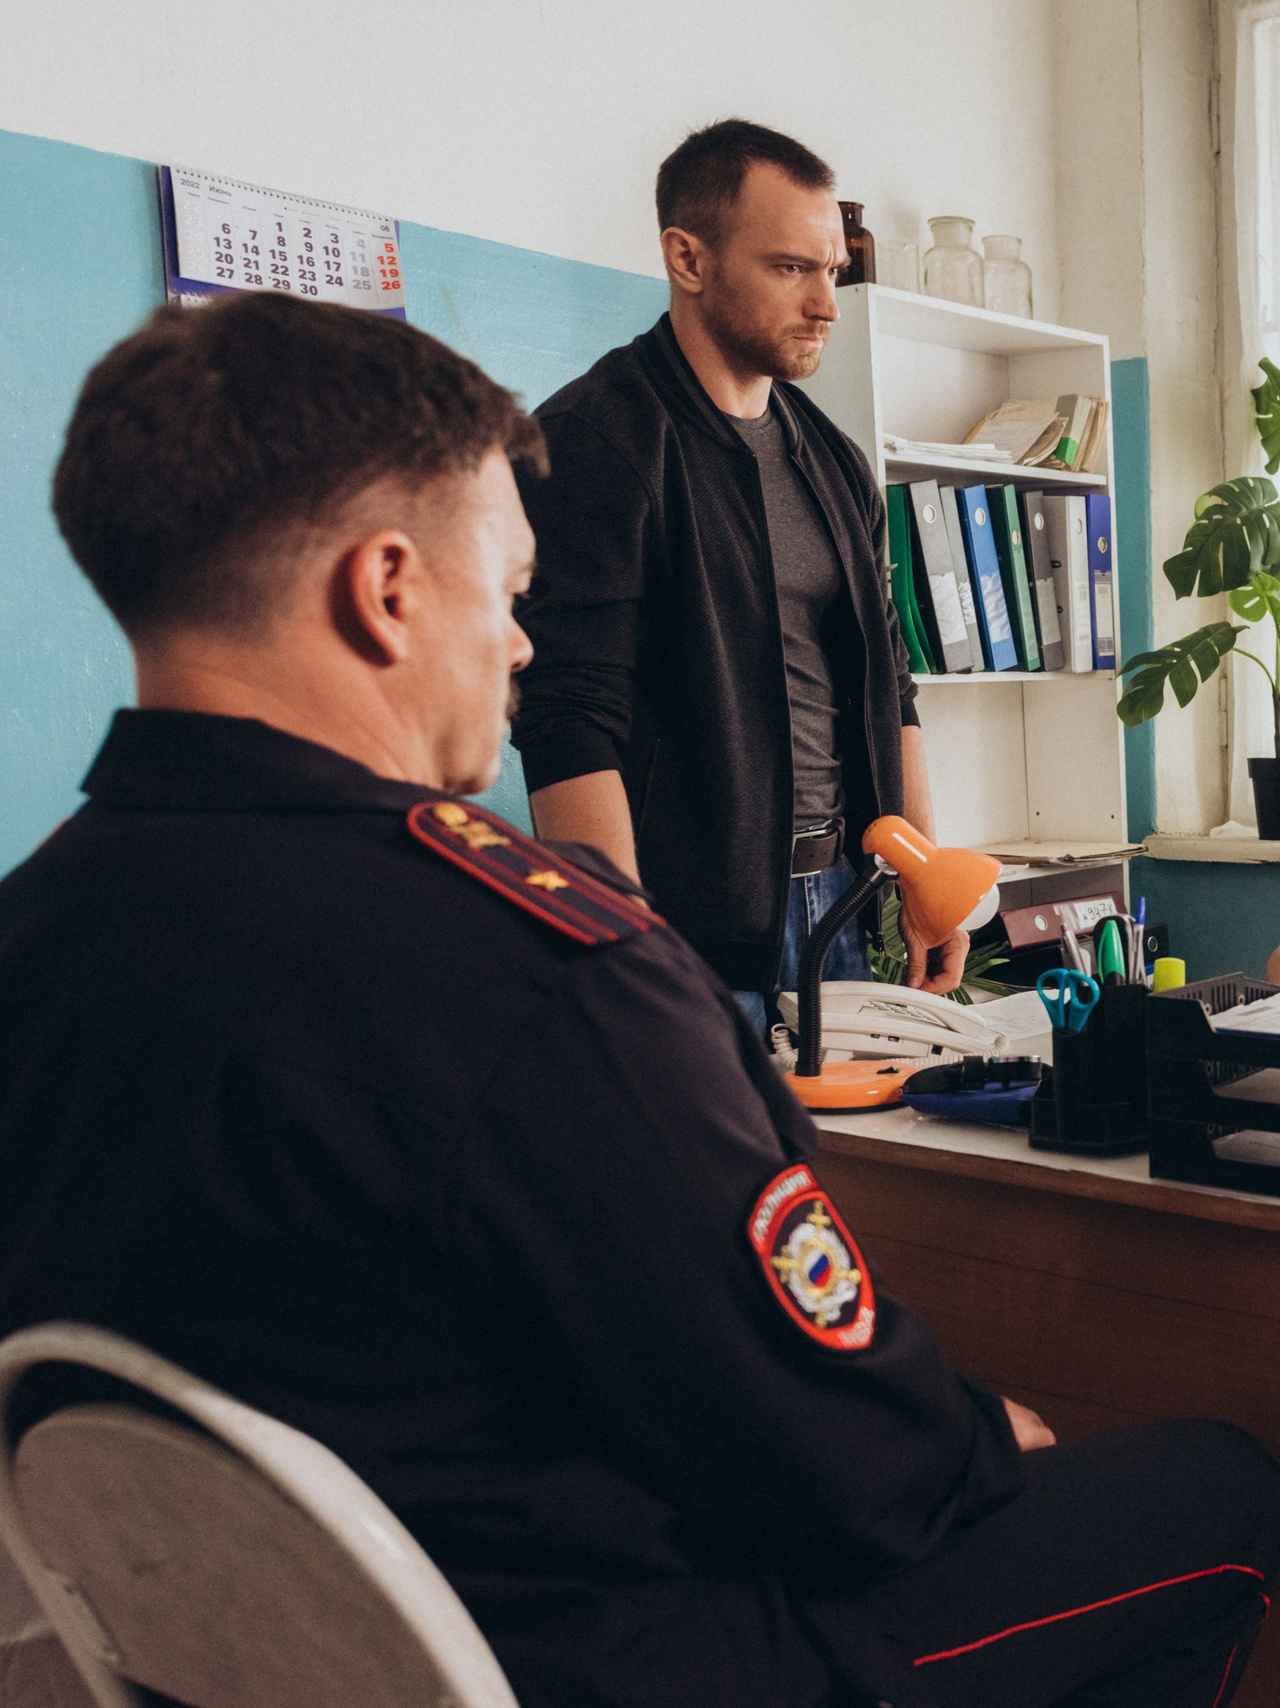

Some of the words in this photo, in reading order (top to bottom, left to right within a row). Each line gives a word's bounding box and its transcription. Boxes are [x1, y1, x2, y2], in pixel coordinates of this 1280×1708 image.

[181, 179, 200, 189] 2022
[209, 185, 232, 197] Июнь
[222, 223, 231, 234] 6
[249, 229, 257, 240] 7
[277, 236, 286, 247] 8
[304, 242, 313, 252] 9
[323, 246, 340, 258] 10
[350, 252, 366, 262] 11
[377, 256, 397, 265] 12
[276, 222, 282, 232] 1
[303, 228, 312, 238] 2
[330, 233, 339, 244] 3
[357, 239, 366, 250] 4
[384, 243, 394, 253] 5
[214, 237, 232, 249] 13
[242, 243, 260, 256] 14
[269, 249, 287, 261] 15
[297, 255, 315, 267] 16
[324, 260, 341, 272] 17
[352, 266, 370, 277] 18
[379, 269, 399, 278] 19
[215, 251, 234, 264] 20
[243, 258, 260, 270] 21
[270, 264, 289, 276] 22
[298, 269, 316, 281] 23
[325, 274, 343, 286] 24
[353, 280, 372, 290] 25
[381, 281, 400, 290] 26
[216, 266, 234, 279] 27
[245, 272, 263, 285] 28
[272, 278, 291, 290] 29
[300, 283, 318, 296] 30
